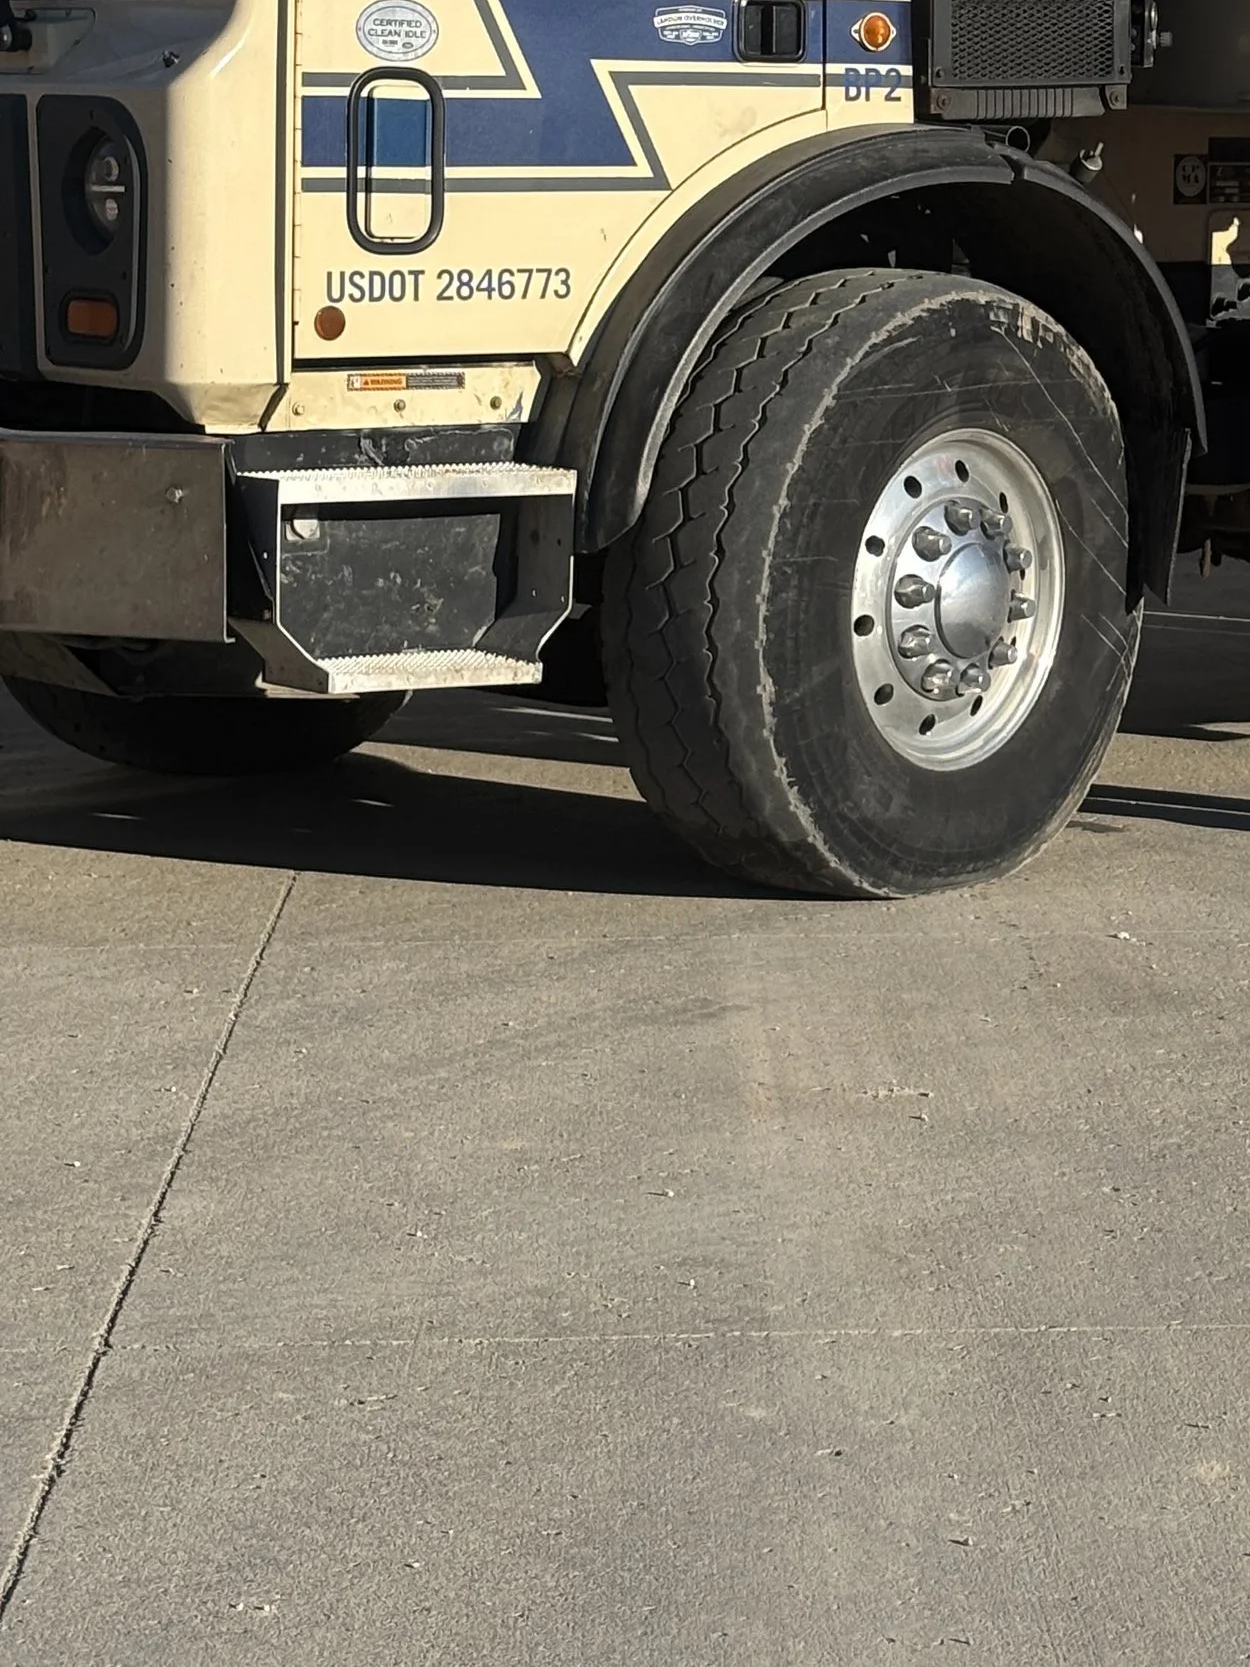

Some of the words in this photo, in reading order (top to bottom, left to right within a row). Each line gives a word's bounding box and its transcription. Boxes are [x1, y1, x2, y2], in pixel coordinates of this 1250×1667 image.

[368, 28, 402, 37] CLEAN
[405, 30, 427, 38] IDLE
[373, 18, 422, 28] CERTIFIED
[844, 67, 902, 103] BP2
[326, 270, 426, 303] USDOT
[436, 267, 572, 301] 2846773
